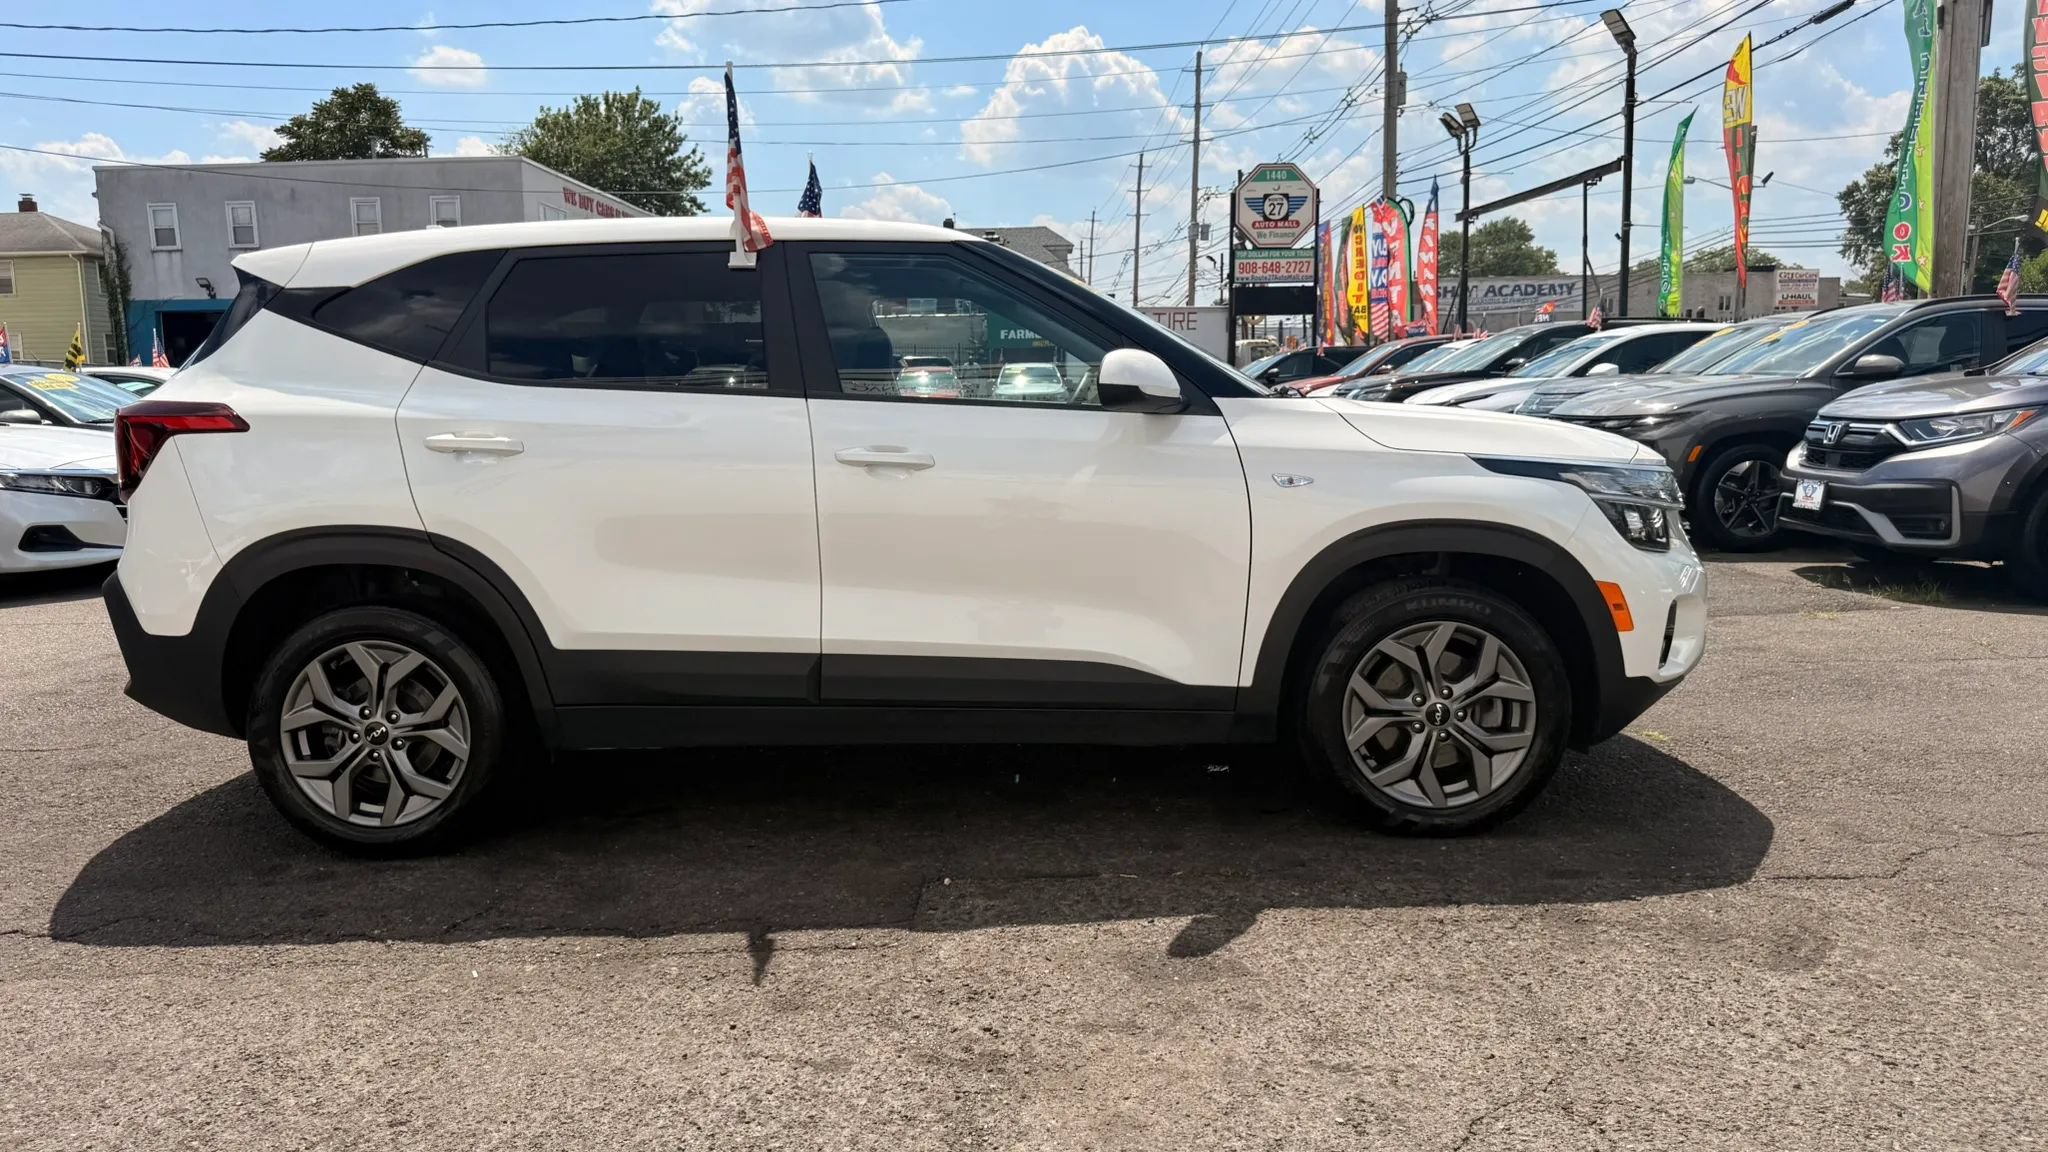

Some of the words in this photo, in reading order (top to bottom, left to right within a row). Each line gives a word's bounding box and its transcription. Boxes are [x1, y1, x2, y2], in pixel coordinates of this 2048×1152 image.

[1266, 170, 1287, 180] 1440
[563, 187, 577, 206] WE
[578, 193, 594, 213] BUY
[1268, 203, 1284, 216] 27
[1254, 221, 1275, 229] AUTO
[1277, 220, 1298, 228] MALL
[1257, 231, 1267, 239] We
[1238, 260, 1311, 274] 908-648-2727
[1484, 282, 1577, 297] ACADEMY
[1153, 311, 1198, 331] TIRE
